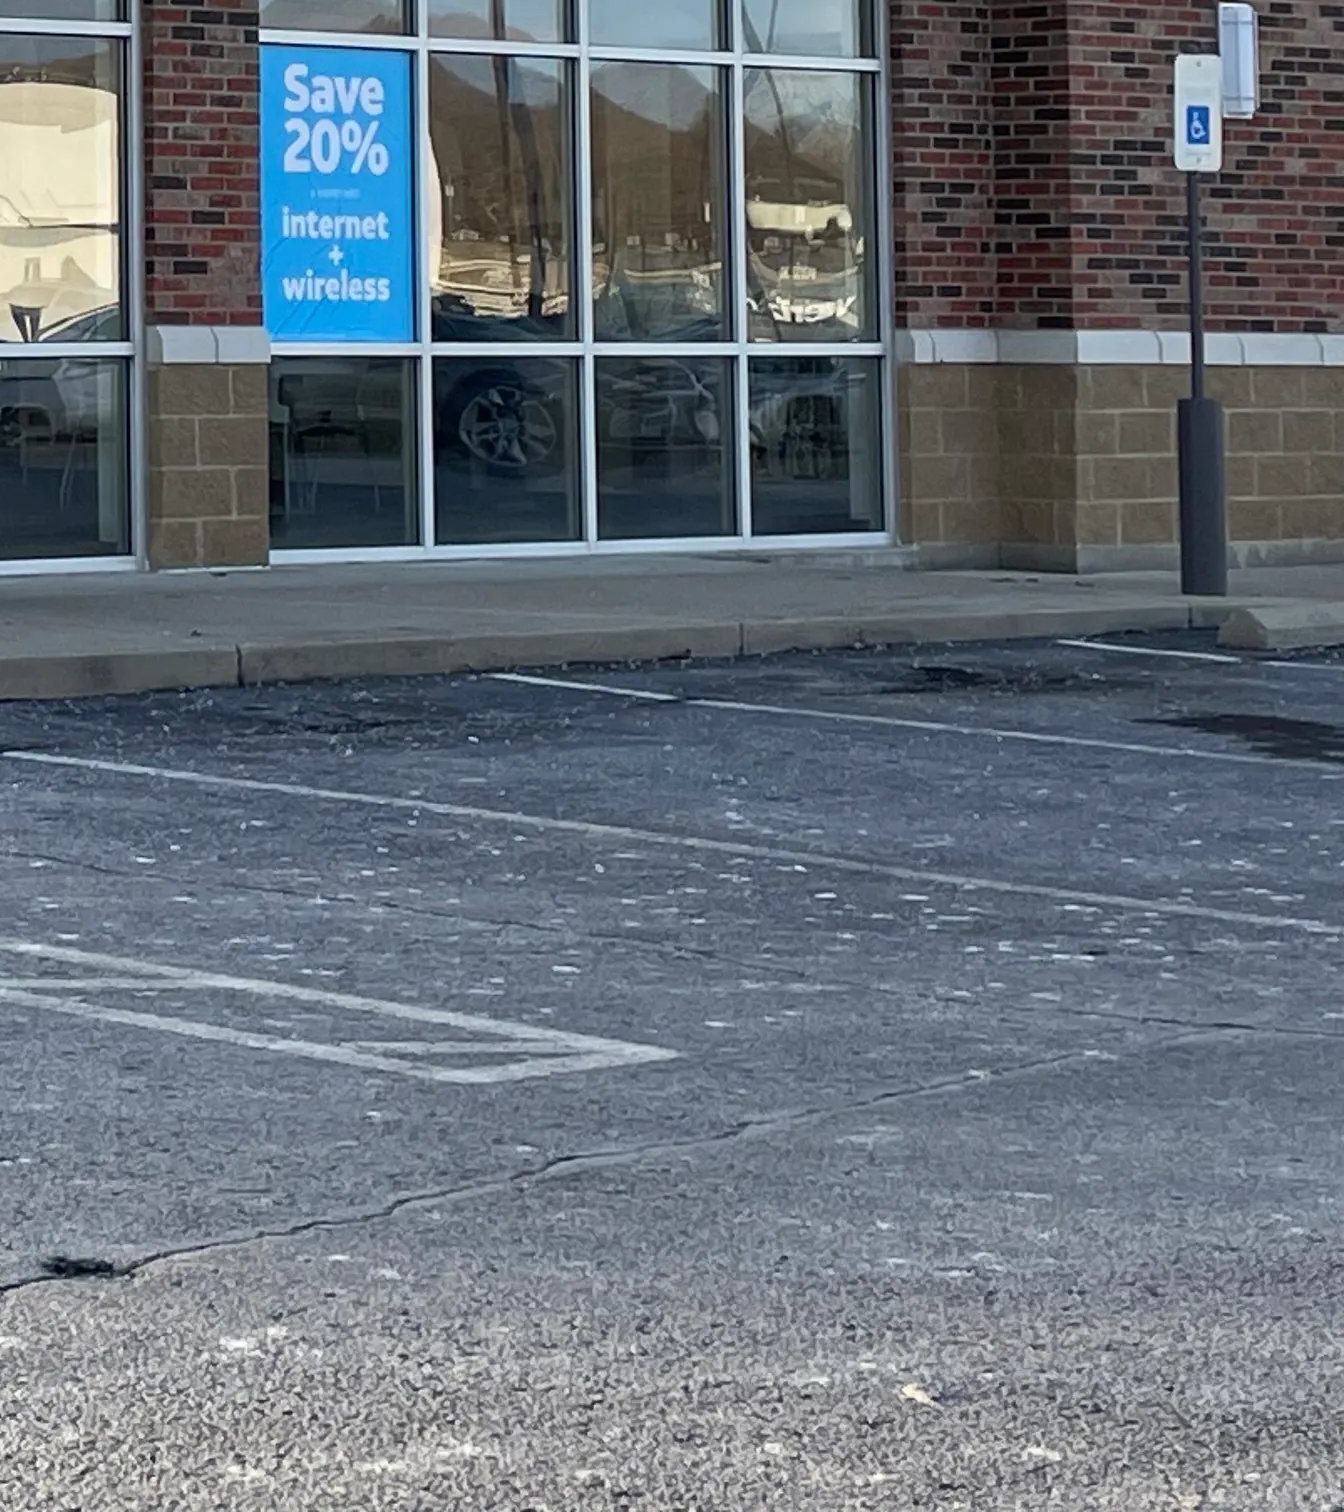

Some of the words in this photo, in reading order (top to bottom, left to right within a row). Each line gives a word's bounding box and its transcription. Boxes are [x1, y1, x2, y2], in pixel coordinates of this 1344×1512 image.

[283, 62, 385, 116] Save
[283, 117, 390, 176] 20%
[282, 206, 390, 240] internet
[328, 244, 344, 266] +
[282, 268, 391, 302] wireless
